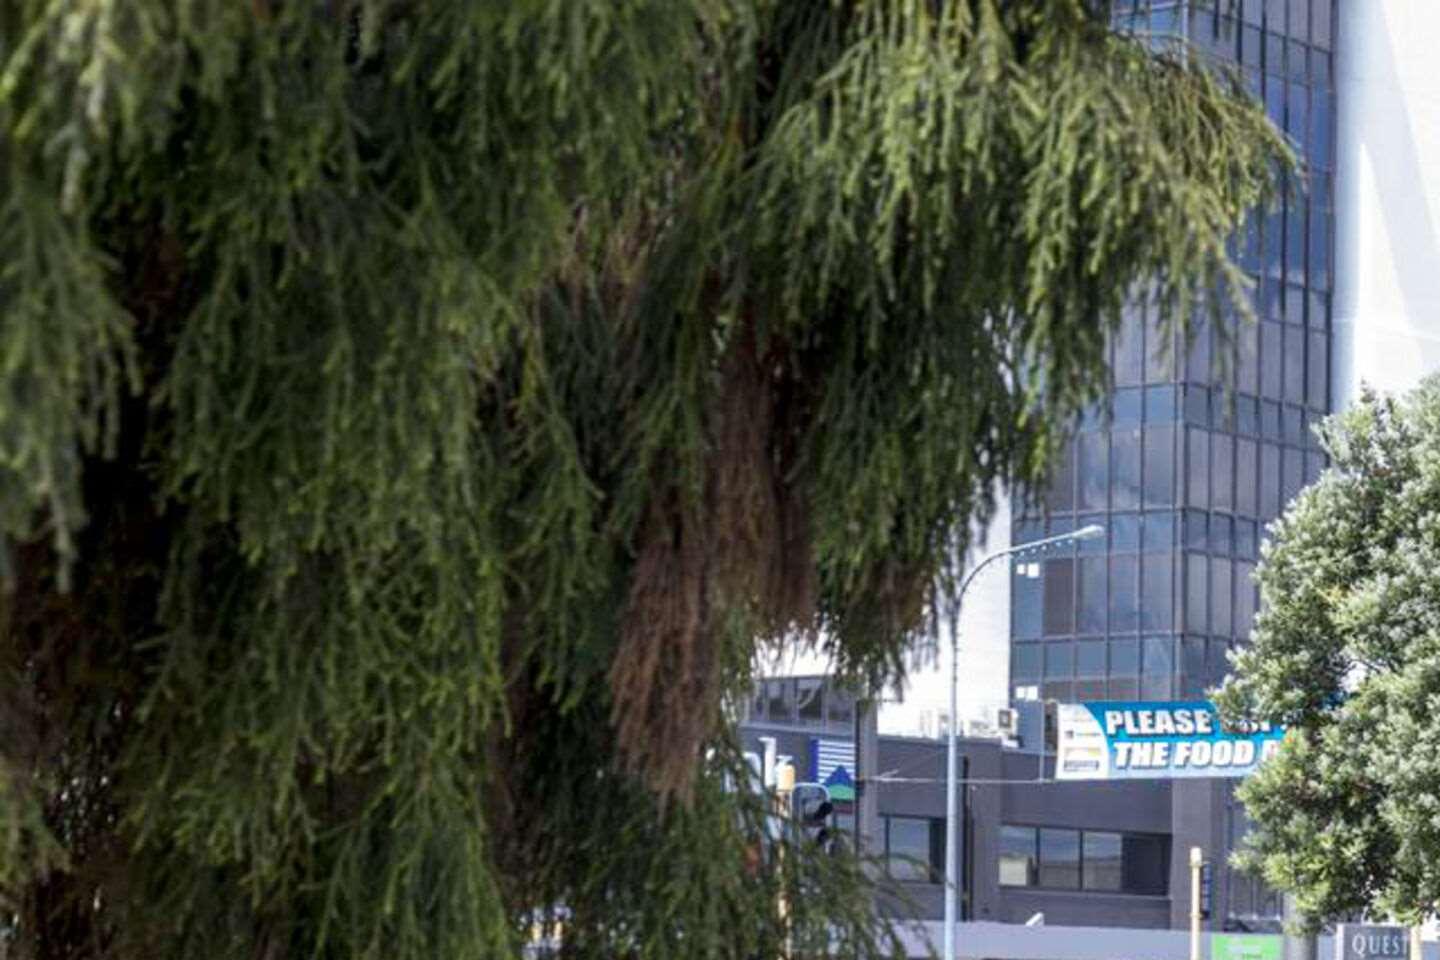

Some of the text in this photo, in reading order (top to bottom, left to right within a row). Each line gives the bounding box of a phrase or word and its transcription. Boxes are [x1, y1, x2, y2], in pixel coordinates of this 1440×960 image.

[1104, 708, 1212, 735] PLEASE
[1113, 741, 1170, 768] THE
[1174, 740, 1254, 767] FOOD
